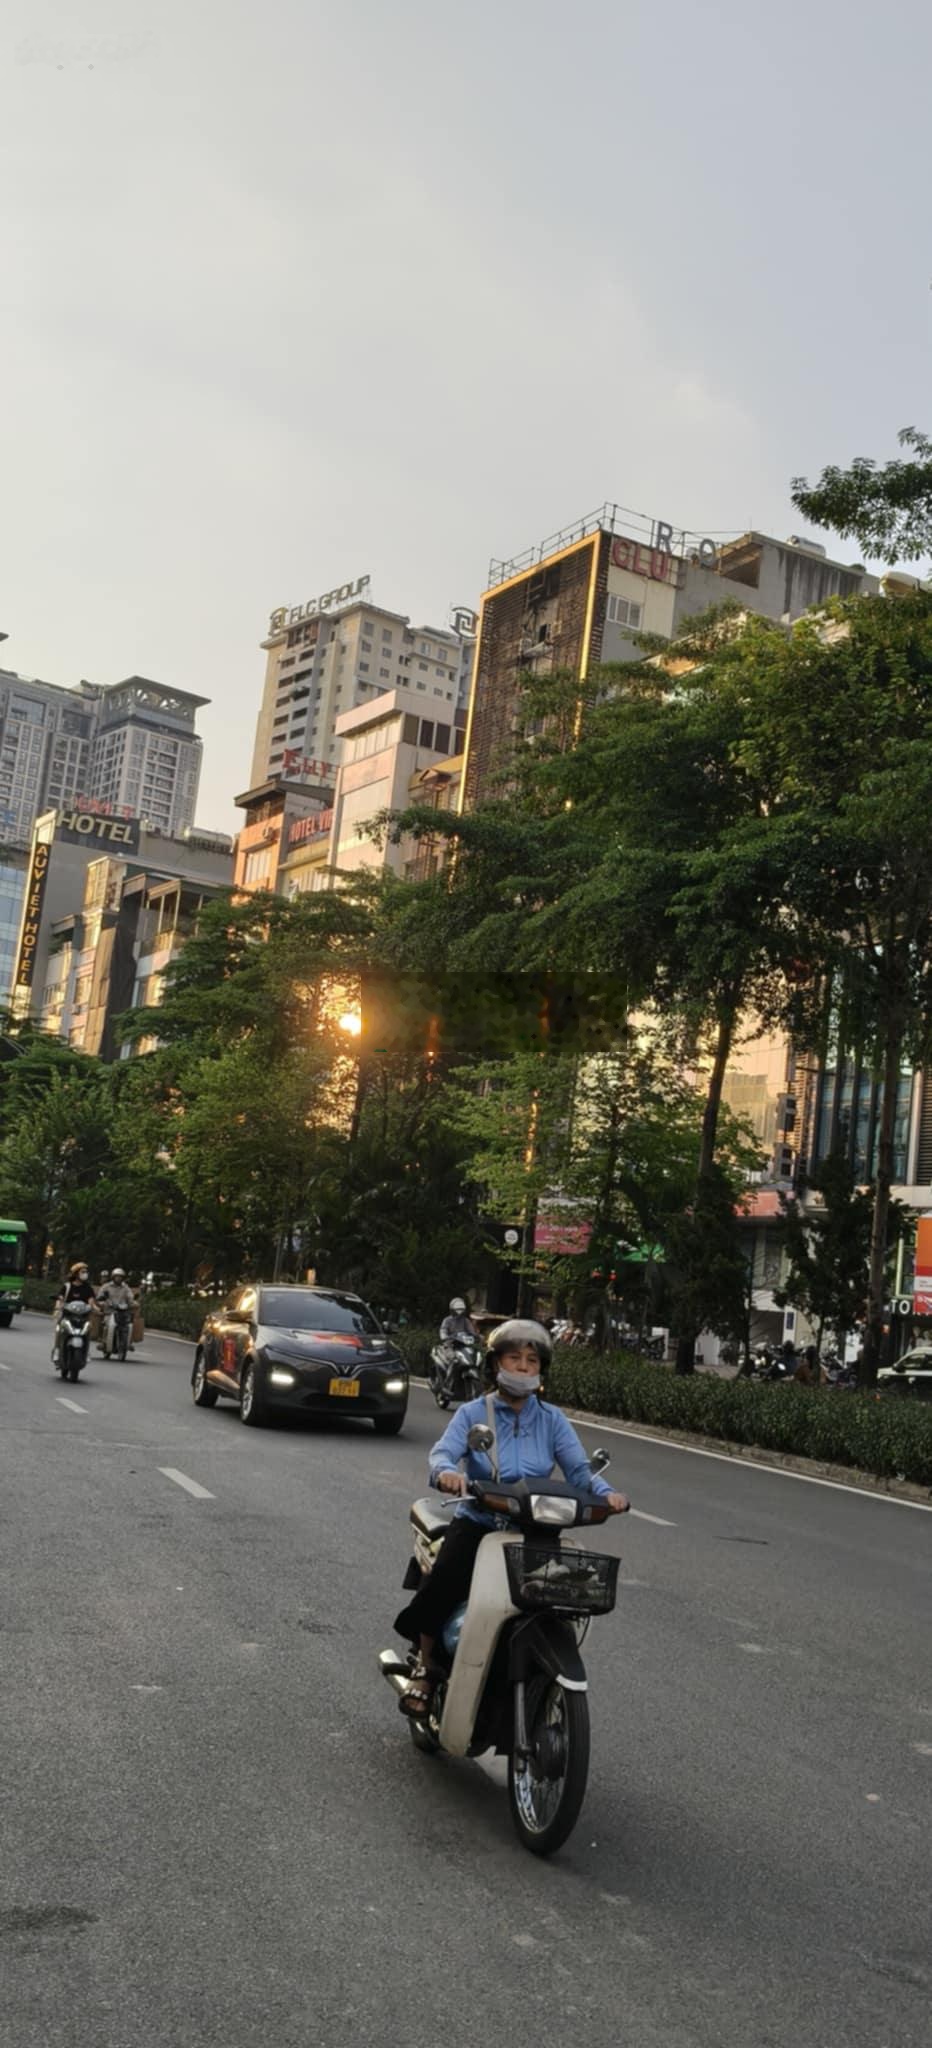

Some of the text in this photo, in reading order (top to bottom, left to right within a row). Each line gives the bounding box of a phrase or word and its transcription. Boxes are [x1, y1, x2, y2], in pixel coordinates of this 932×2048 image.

[289, 574, 370, 624] FLC GROUP
[56, 811, 134, 844] HOTEL
[20, 922, 38, 984] HOTEL
